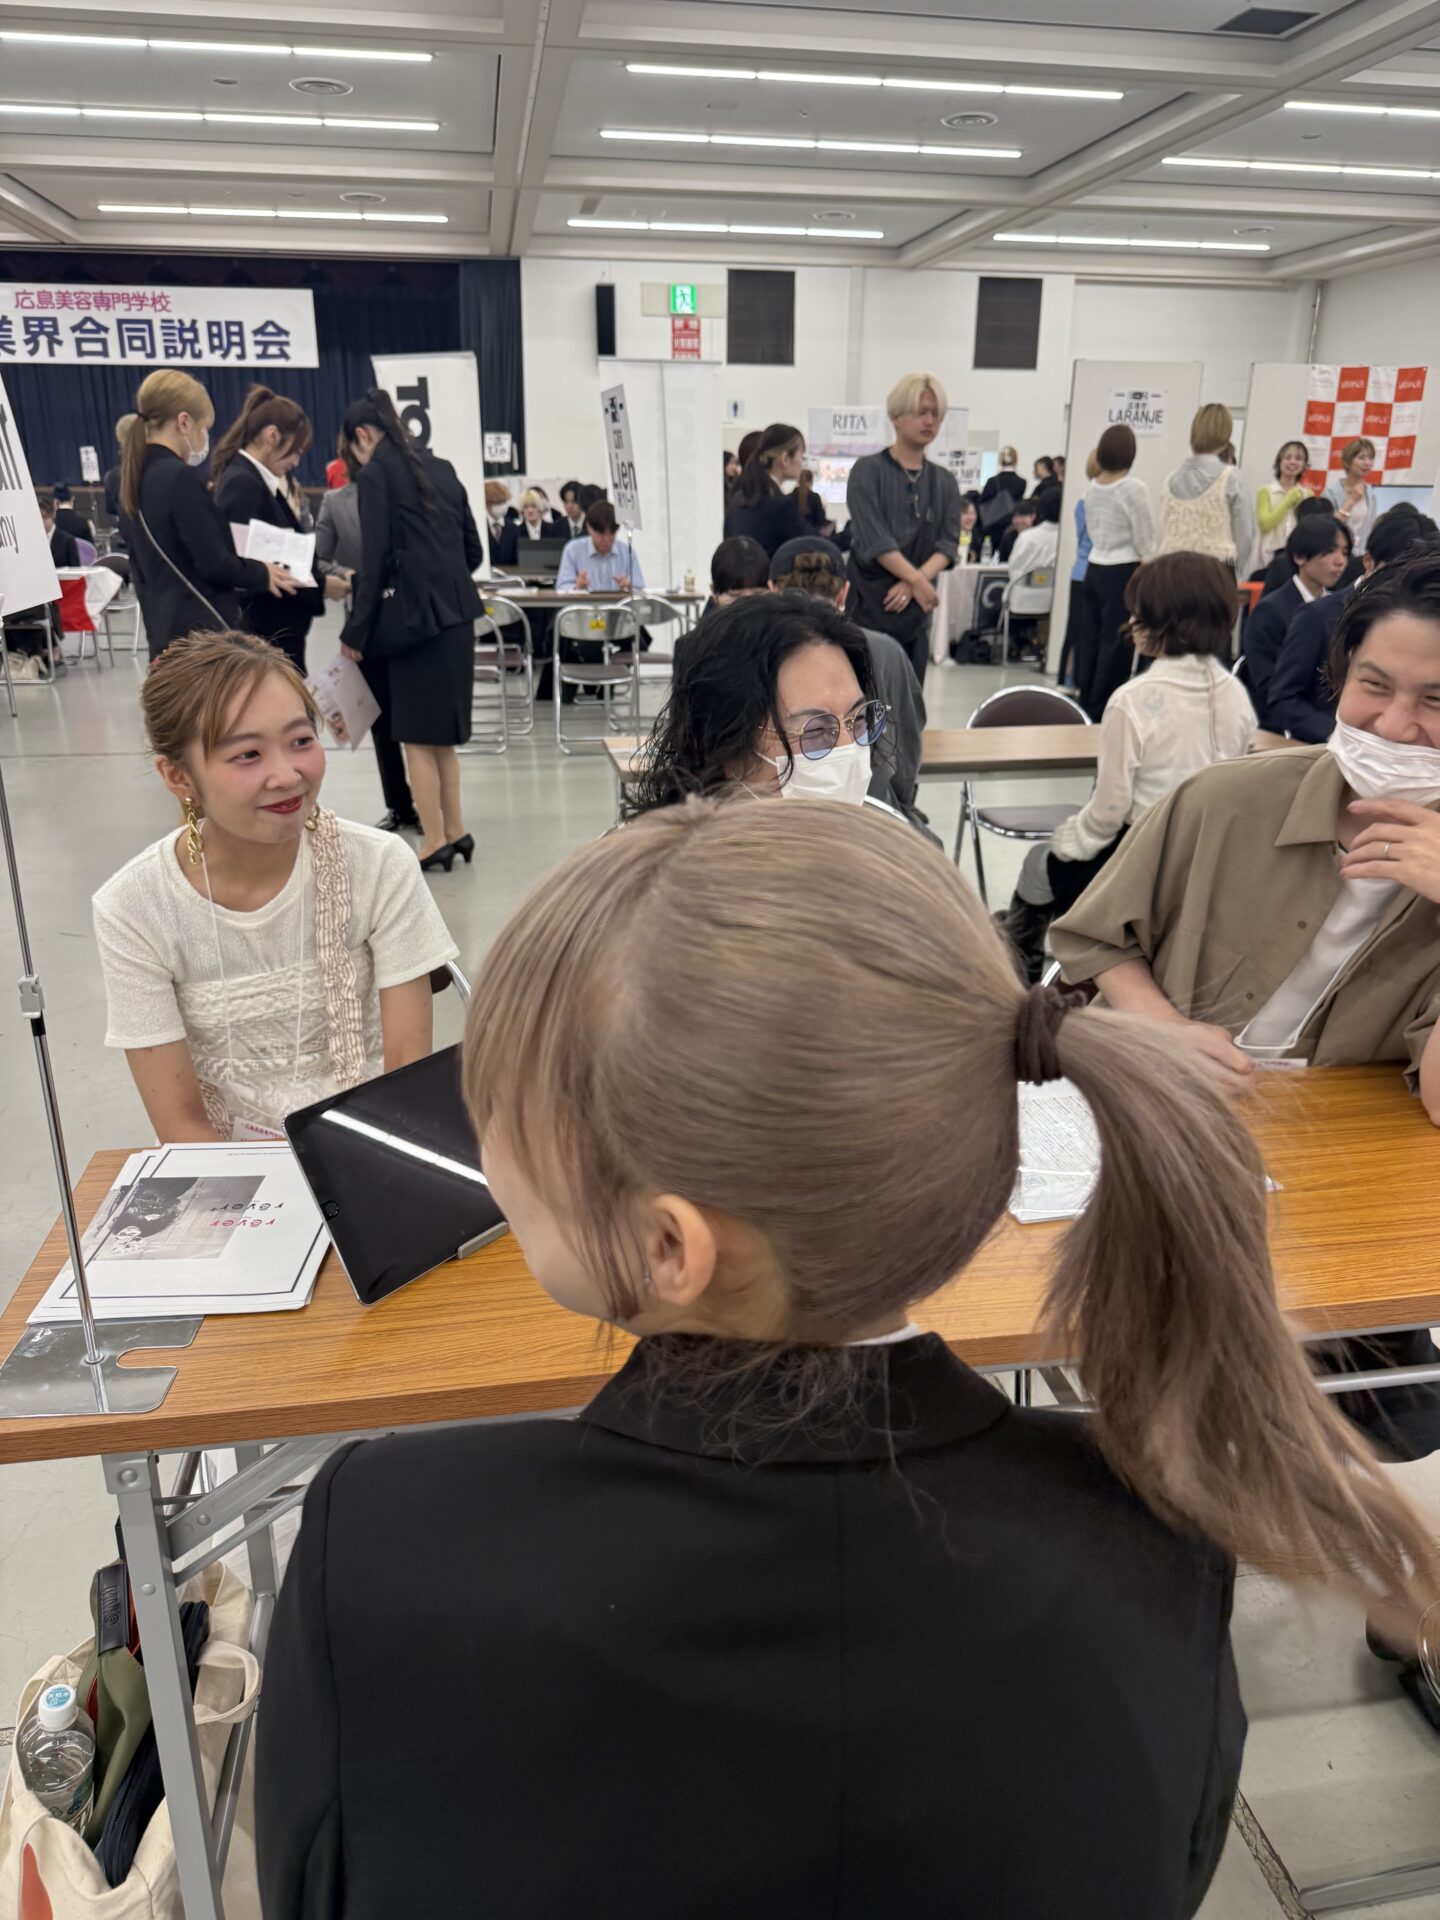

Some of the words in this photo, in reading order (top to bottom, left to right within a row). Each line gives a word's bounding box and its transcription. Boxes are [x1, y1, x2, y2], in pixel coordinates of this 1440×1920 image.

[15, 290, 172, 312] 広島美容専門学校
[396, 376, 432, 449] TO
[832, 414, 868, 430] RITA
[1108, 409, 1163, 424] LARANJE
[609, 452, 638, 492] Lien
